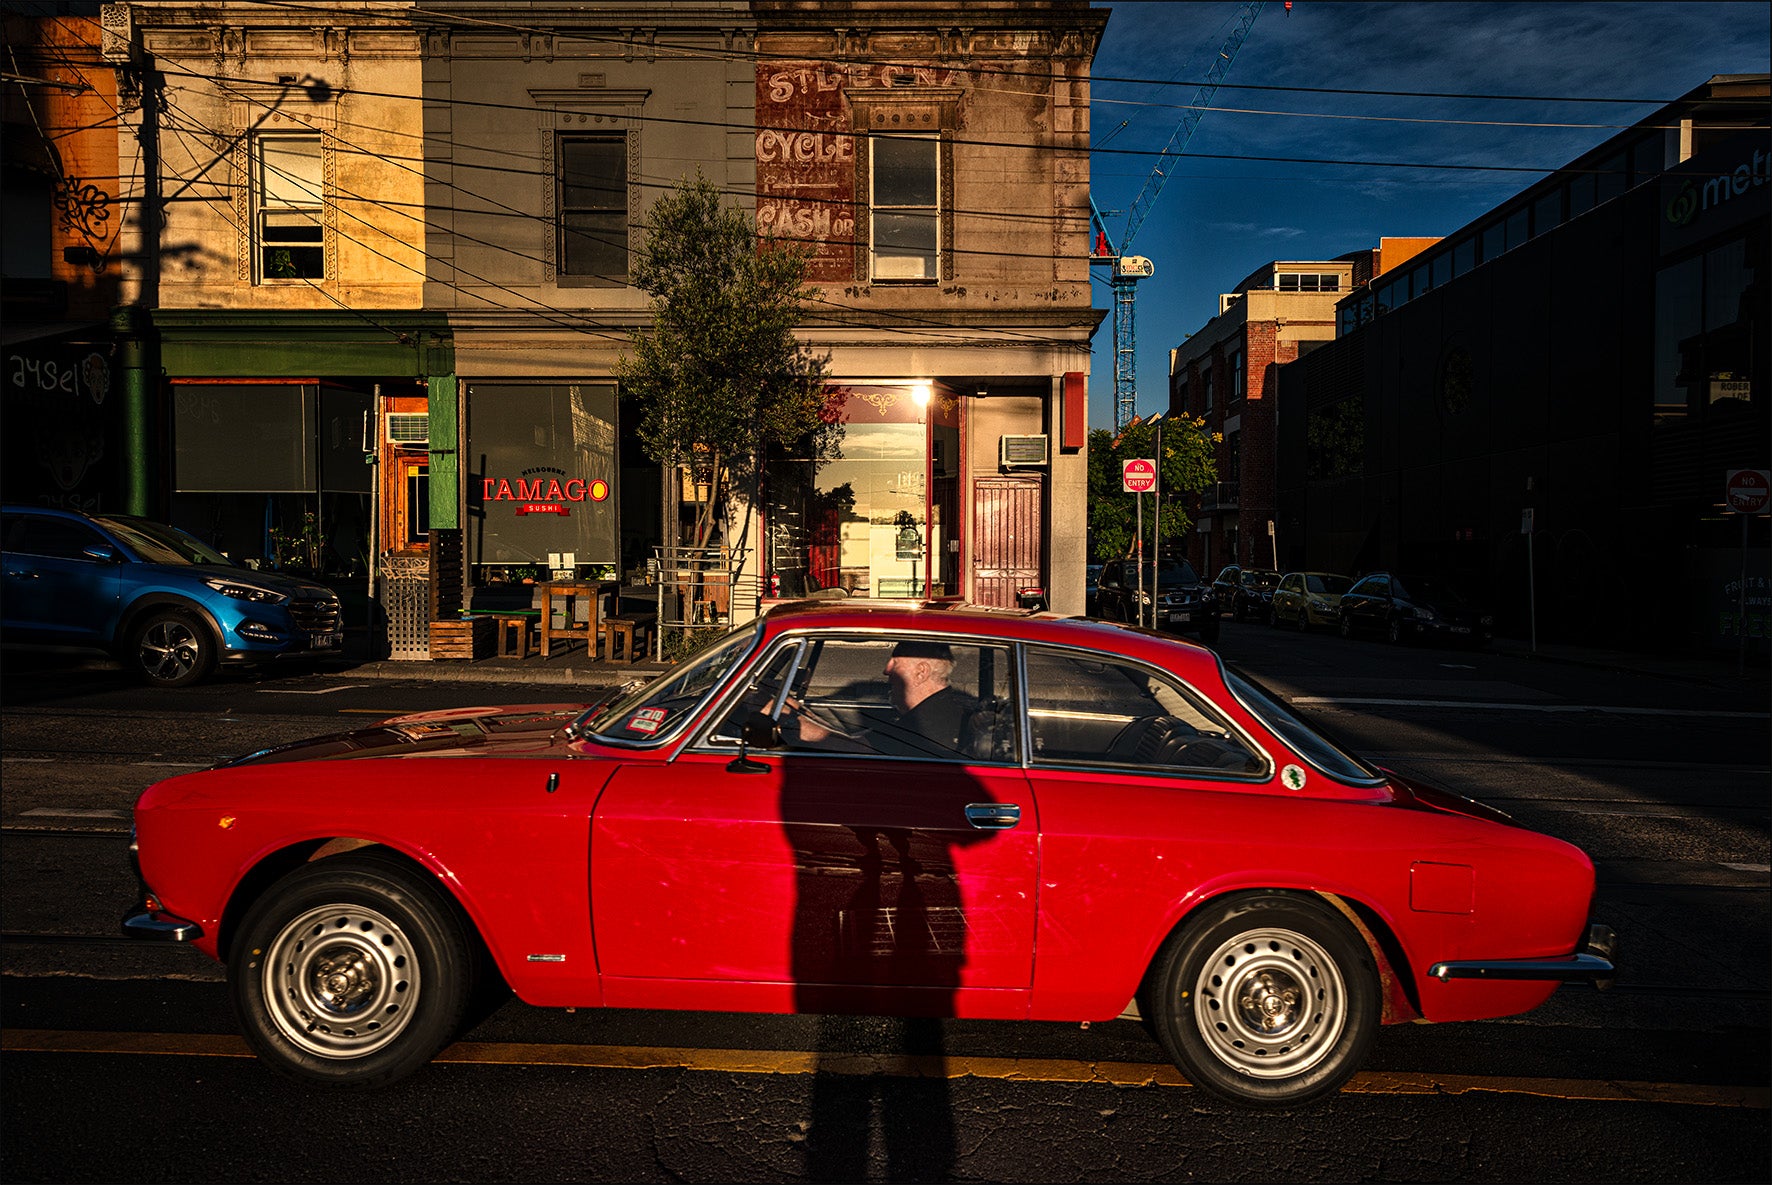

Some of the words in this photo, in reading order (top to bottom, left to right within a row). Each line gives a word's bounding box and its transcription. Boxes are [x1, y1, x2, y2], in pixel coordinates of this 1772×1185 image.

[756, 130, 855, 163] CYCLE
[756, 205, 830, 238] CASH
[832, 217, 855, 237] OR
[521, 466, 566, 477] MELBOURNE
[479, 478, 610, 502] TAMAGO
[1741, 477, 1755, 486] NO
[528, 505, 558, 513] SUSHI
